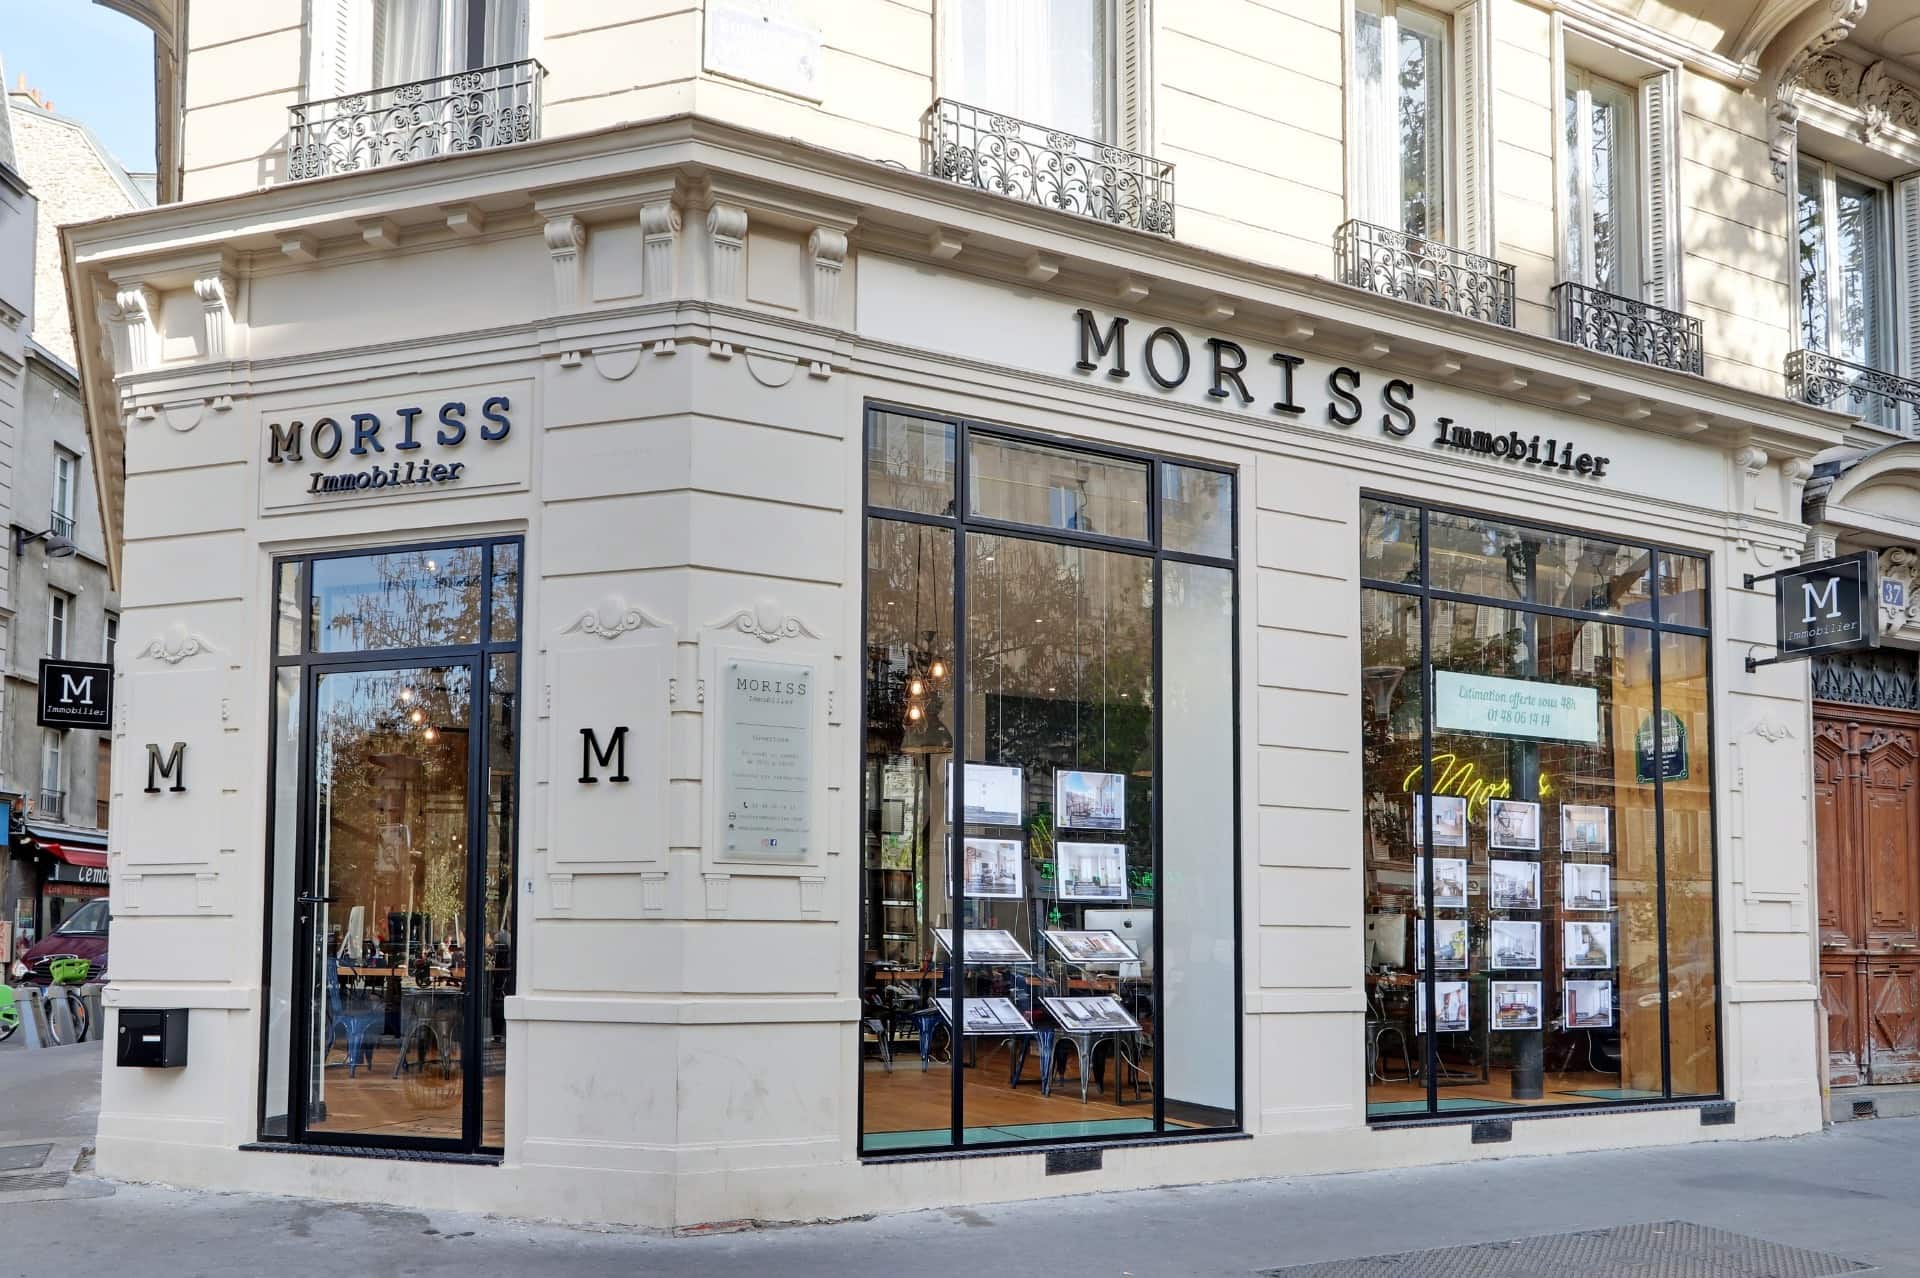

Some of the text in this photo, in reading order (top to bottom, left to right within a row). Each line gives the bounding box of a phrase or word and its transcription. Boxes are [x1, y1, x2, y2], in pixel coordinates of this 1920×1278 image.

[1076, 308, 1610, 477] MORISS Immobilier
[268, 396, 511, 464] MORISS
[306, 459, 465, 494] Immobilier
[1801, 577, 1842, 623] M
[1885, 583, 1902, 603] 37
[1788, 622, 1857, 640] Immobilier
[60, 674, 94, 704] M
[737, 678, 807, 696] MORISS
[1459, 685, 1506, 702] Estimation
[1509, 692, 1536, 710] offerte
[1560, 696, 1576, 711] 48h
[47, 705, 106, 716] Immobilier
[1488, 708, 1498, 721] 01
[1500, 709, 1513, 722] 48
[1514, 711, 1527, 724] 06
[144, 742, 187, 793] M
[578, 726, 629, 783] M
